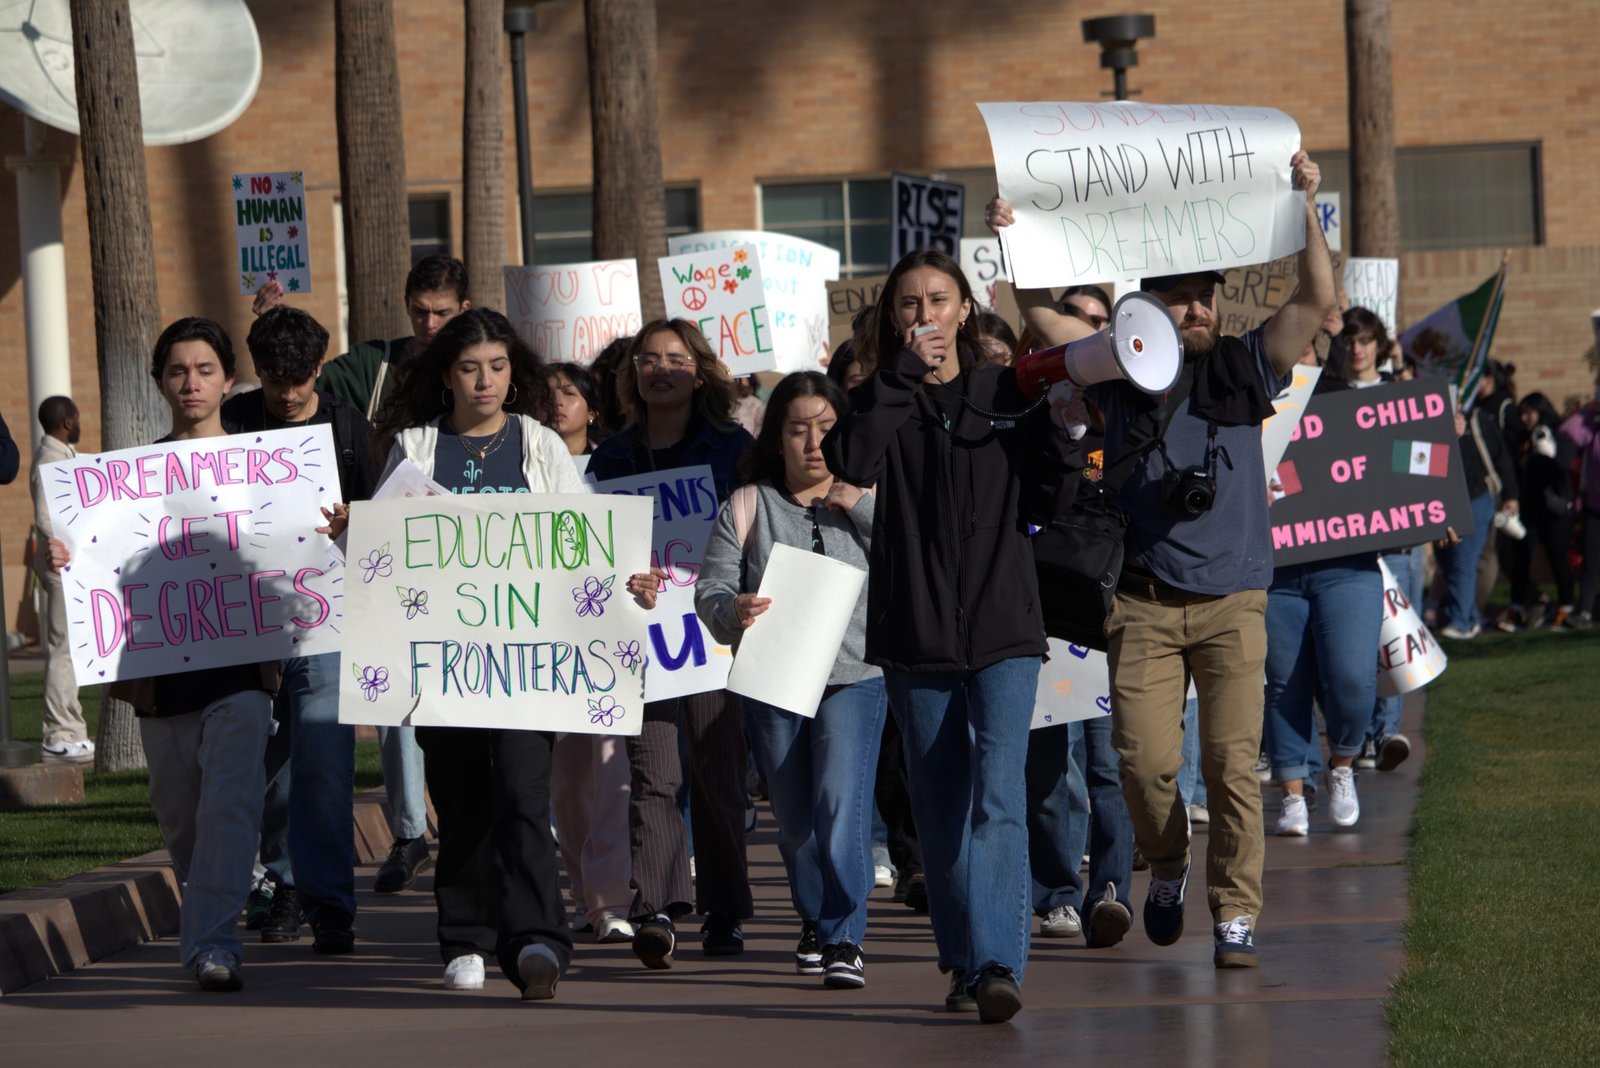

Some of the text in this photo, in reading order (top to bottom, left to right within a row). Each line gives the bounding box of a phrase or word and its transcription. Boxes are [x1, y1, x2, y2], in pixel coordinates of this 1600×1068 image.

[250, 176, 272, 195] NO
[1025, 126, 1255, 211] STAND WITH
[236, 197, 302, 226] HUMAN
[898, 180, 958, 235] RISE
[241, 244, 306, 272] ILLEGAL
[259, 228, 273, 242] IS
[1061, 192, 1255, 278] DREAMERS
[672, 263, 732, 290] Wage
[689, 305, 773, 360] EACE
[1355, 393, 1445, 430] CHILD
[74, 448, 298, 508] DREAMERS
[1331, 456, 1367, 483] OF
[158, 509, 253, 560] GET
[404, 509, 615, 571] EDUCATION
[1271, 501, 1447, 550] MMIGRANTS
[90, 567, 330, 658] DEGREES
[456, 582, 541, 630] SIN
[409, 639, 617, 699] FRONTERAS
